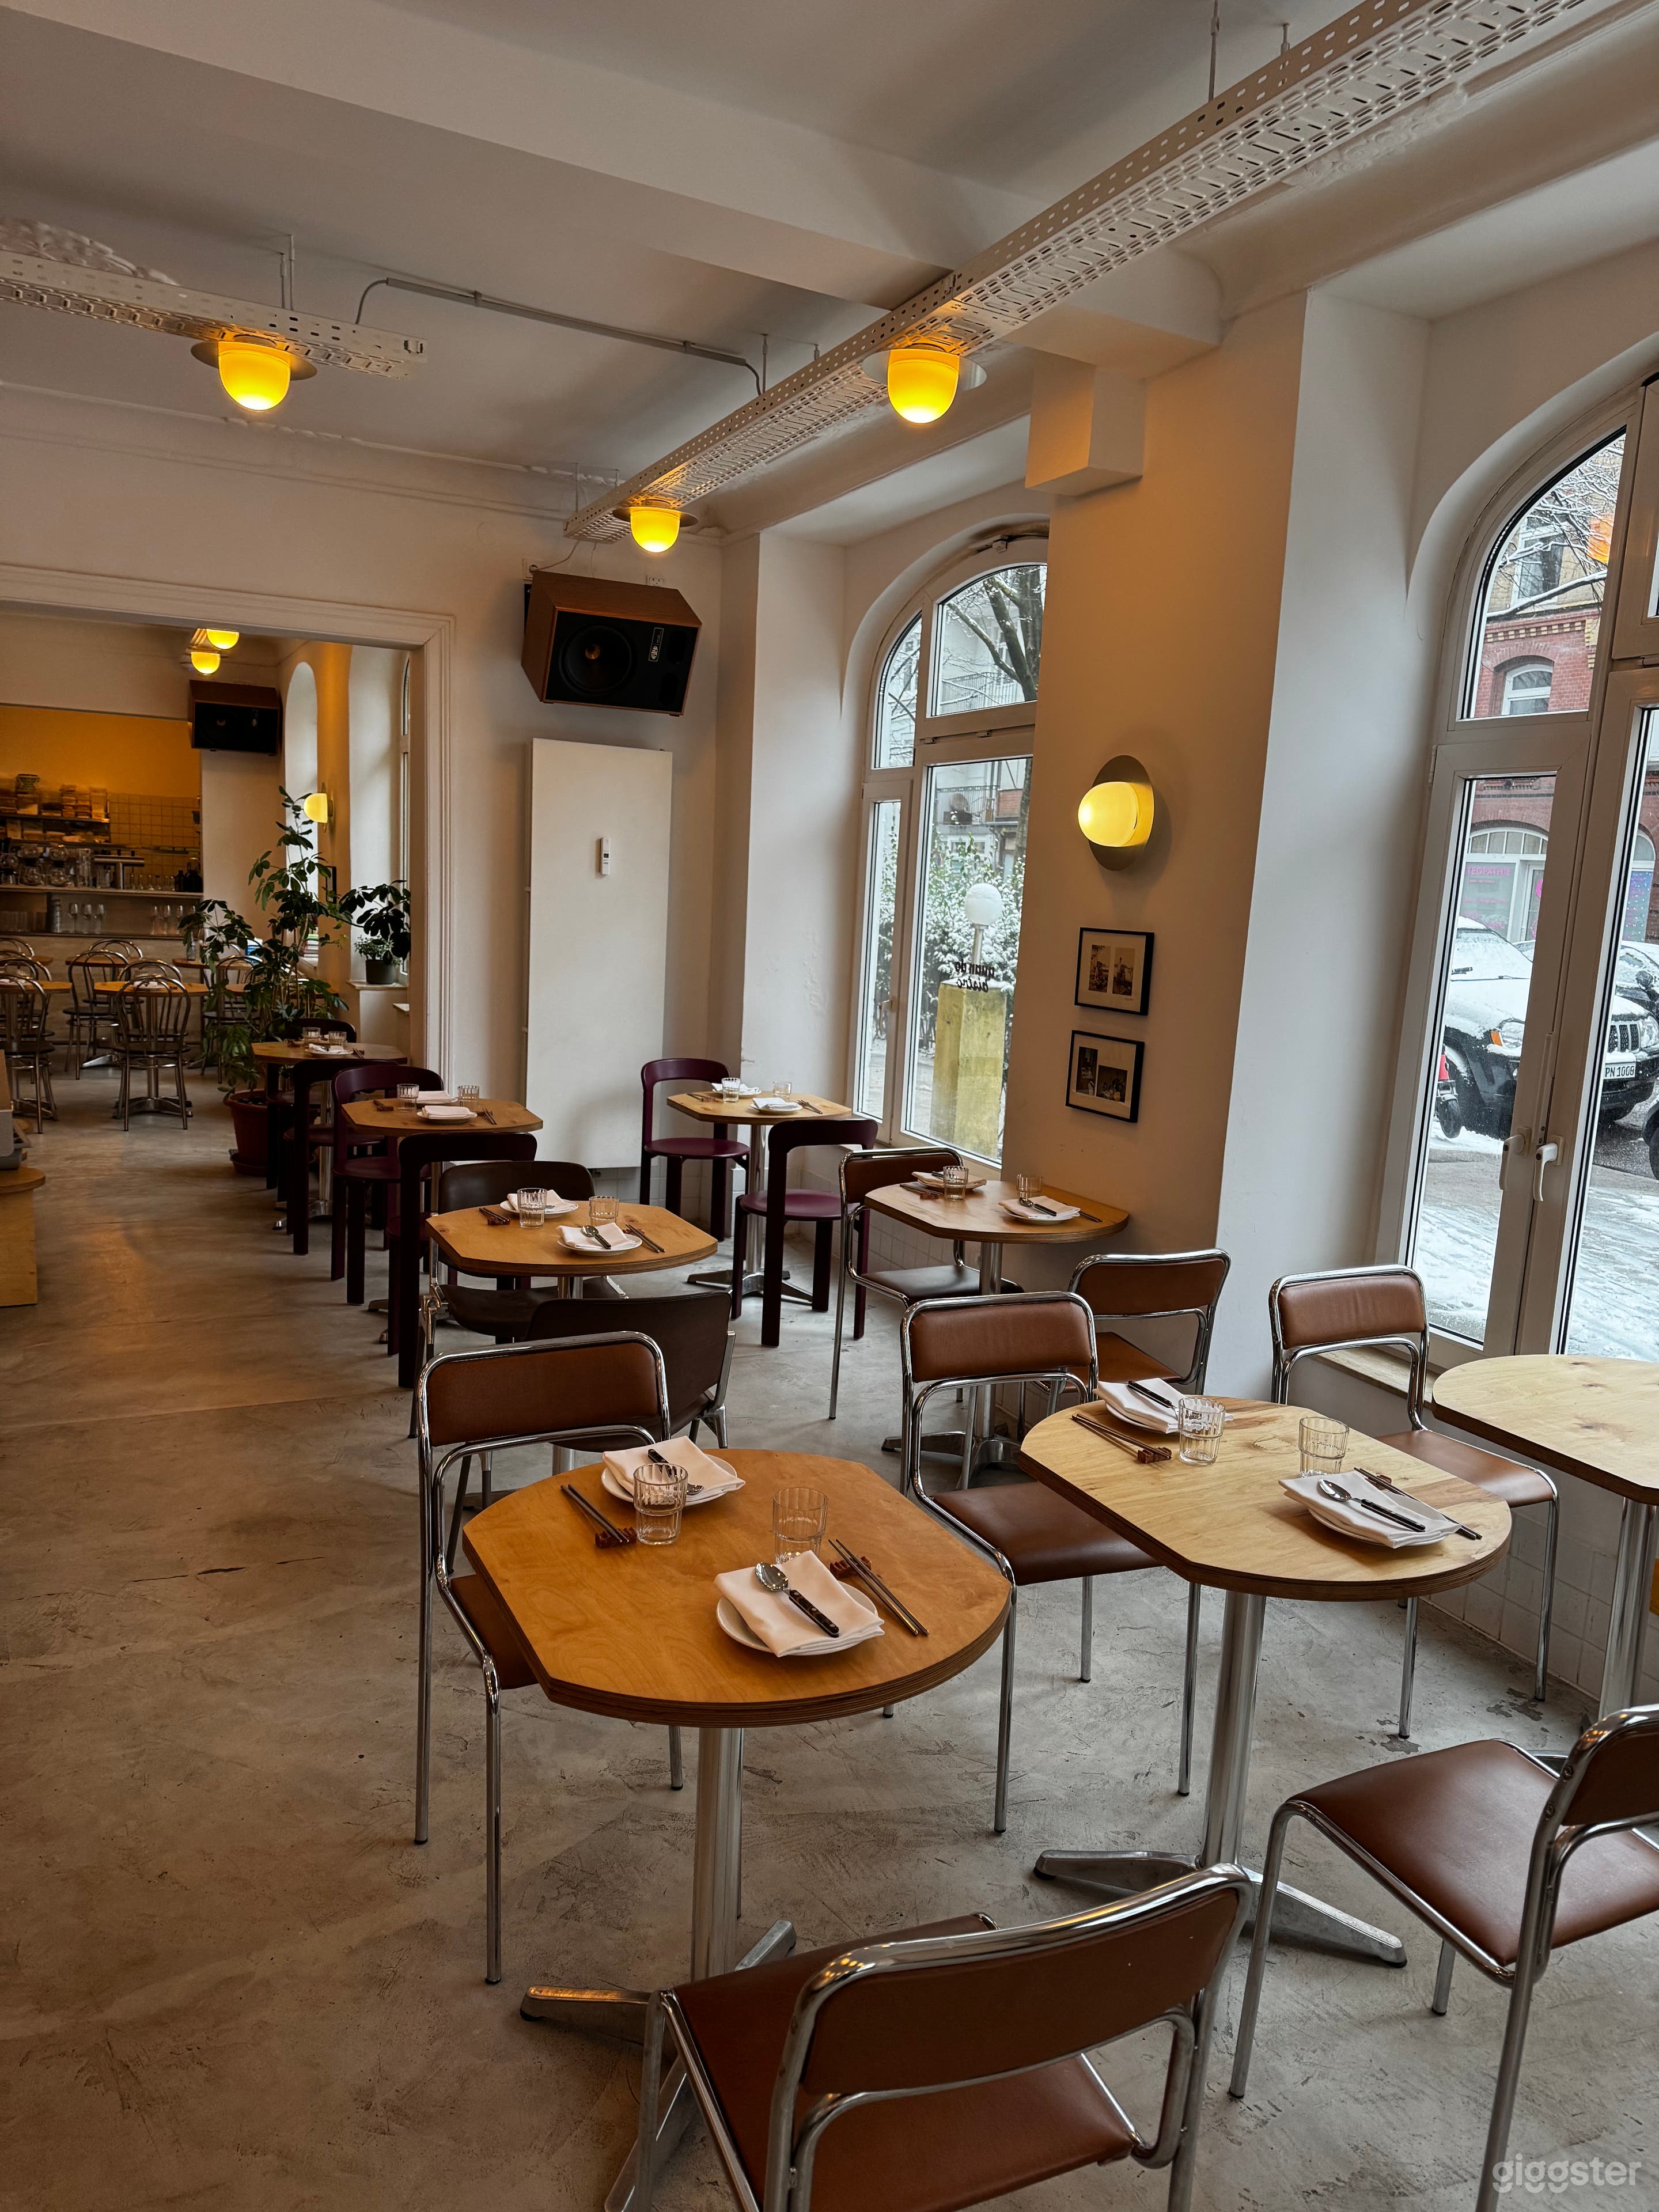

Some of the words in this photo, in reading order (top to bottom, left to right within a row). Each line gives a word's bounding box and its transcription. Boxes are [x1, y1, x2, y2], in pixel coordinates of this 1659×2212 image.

[1465, 867, 1511, 876] TEOPATHIE
[1605, 1067, 1615, 1077] PN
[1616, 1066, 1634, 1077] 1008
